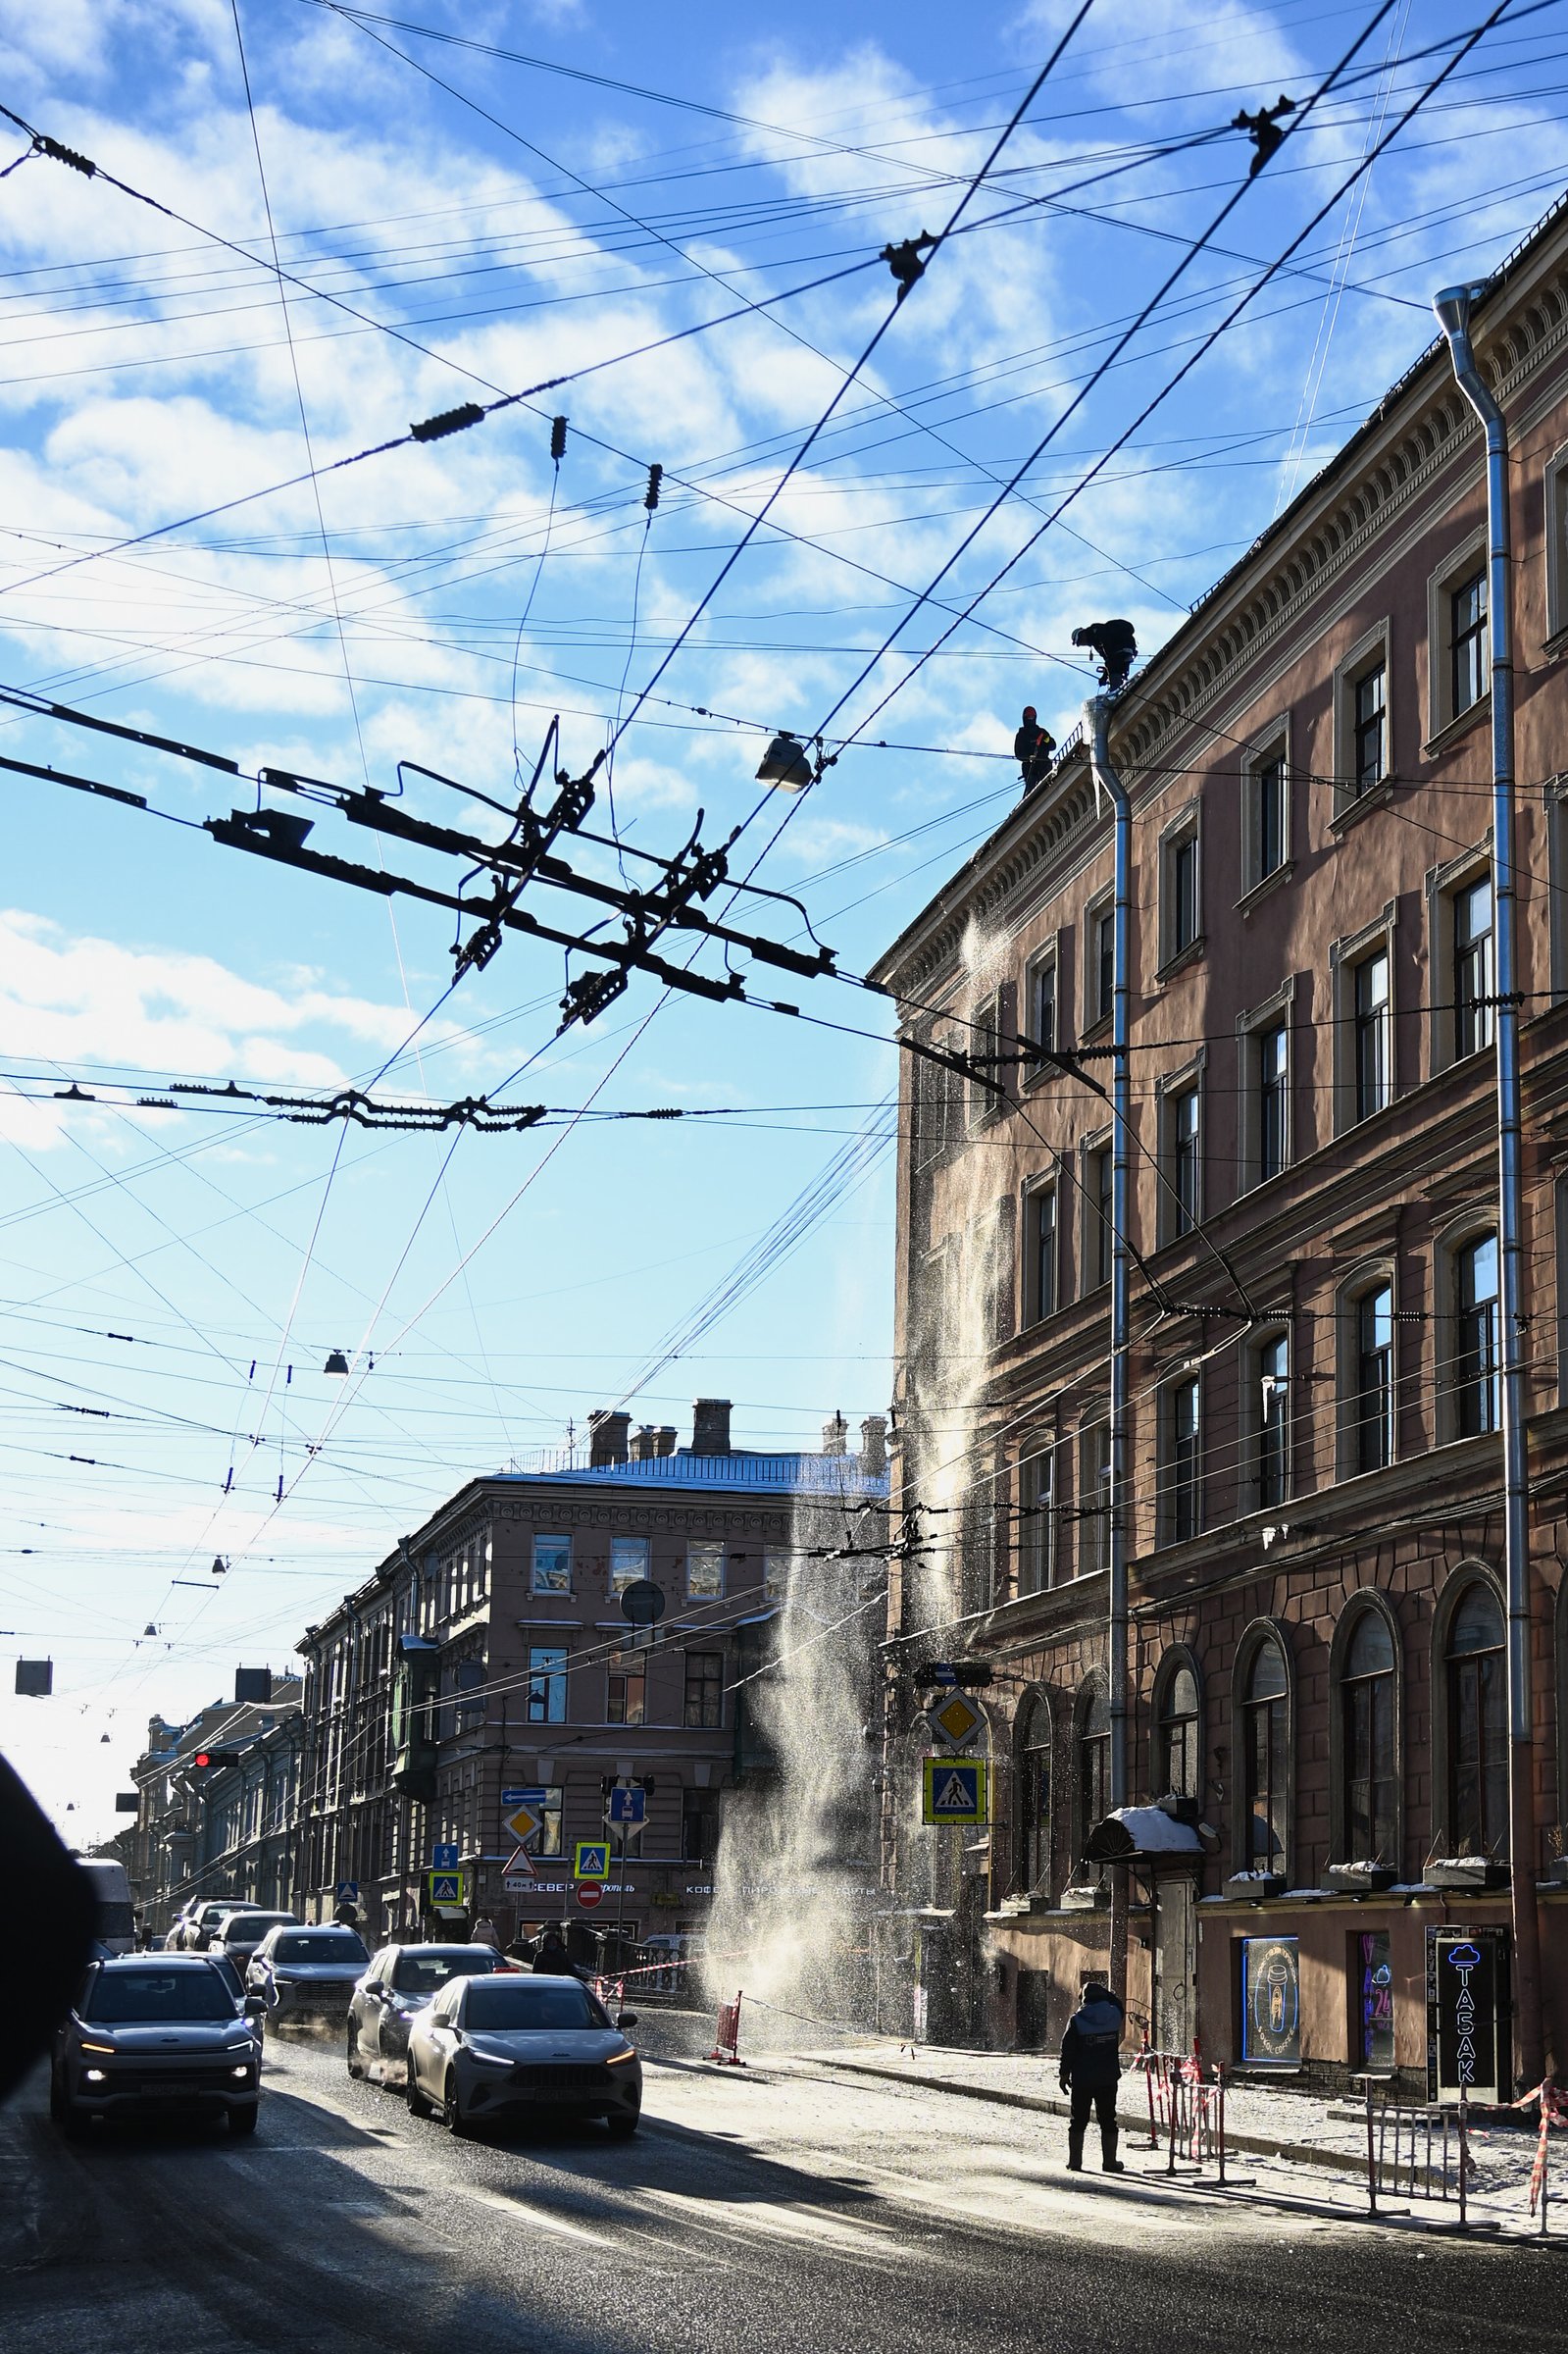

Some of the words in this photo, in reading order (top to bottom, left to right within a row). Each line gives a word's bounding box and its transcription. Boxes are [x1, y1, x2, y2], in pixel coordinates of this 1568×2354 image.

[685, 1885, 721, 1894] КОФЕ
[836, 1886, 876, 1896] ТОРТЫ
[1375, 1988, 1391, 2019] 24
[1455, 1964, 1476, 2083] ТАБАК
